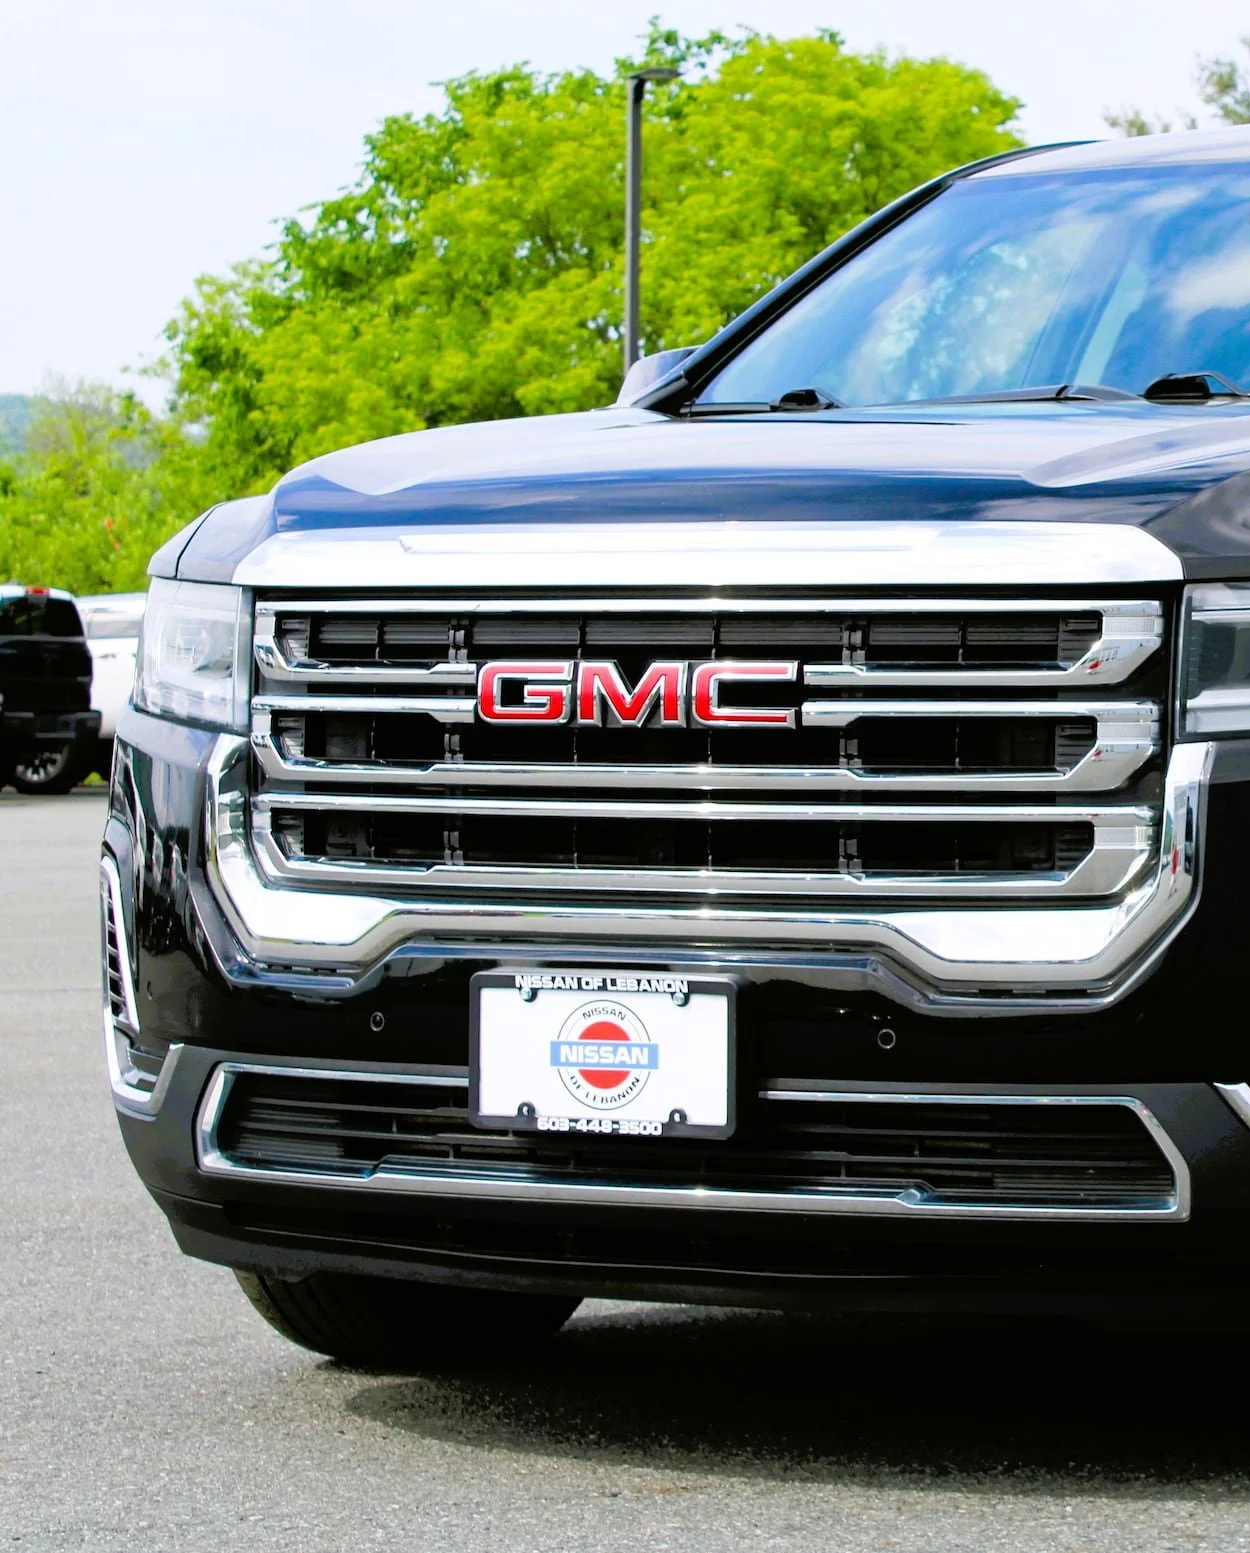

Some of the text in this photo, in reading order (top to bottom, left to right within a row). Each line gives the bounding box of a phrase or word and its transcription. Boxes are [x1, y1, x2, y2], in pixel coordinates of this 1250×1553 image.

[478, 660, 798, 729] GMC
[515, 975, 688, 993] NISSAN OF LEBANON
[582, 1007, 626, 1021] NISSAN
[560, 1044, 649, 1065] NISSAN
[570, 1075, 640, 1104] OF LEBANON
[537, 1116, 662, 1136] 603-448-3500
